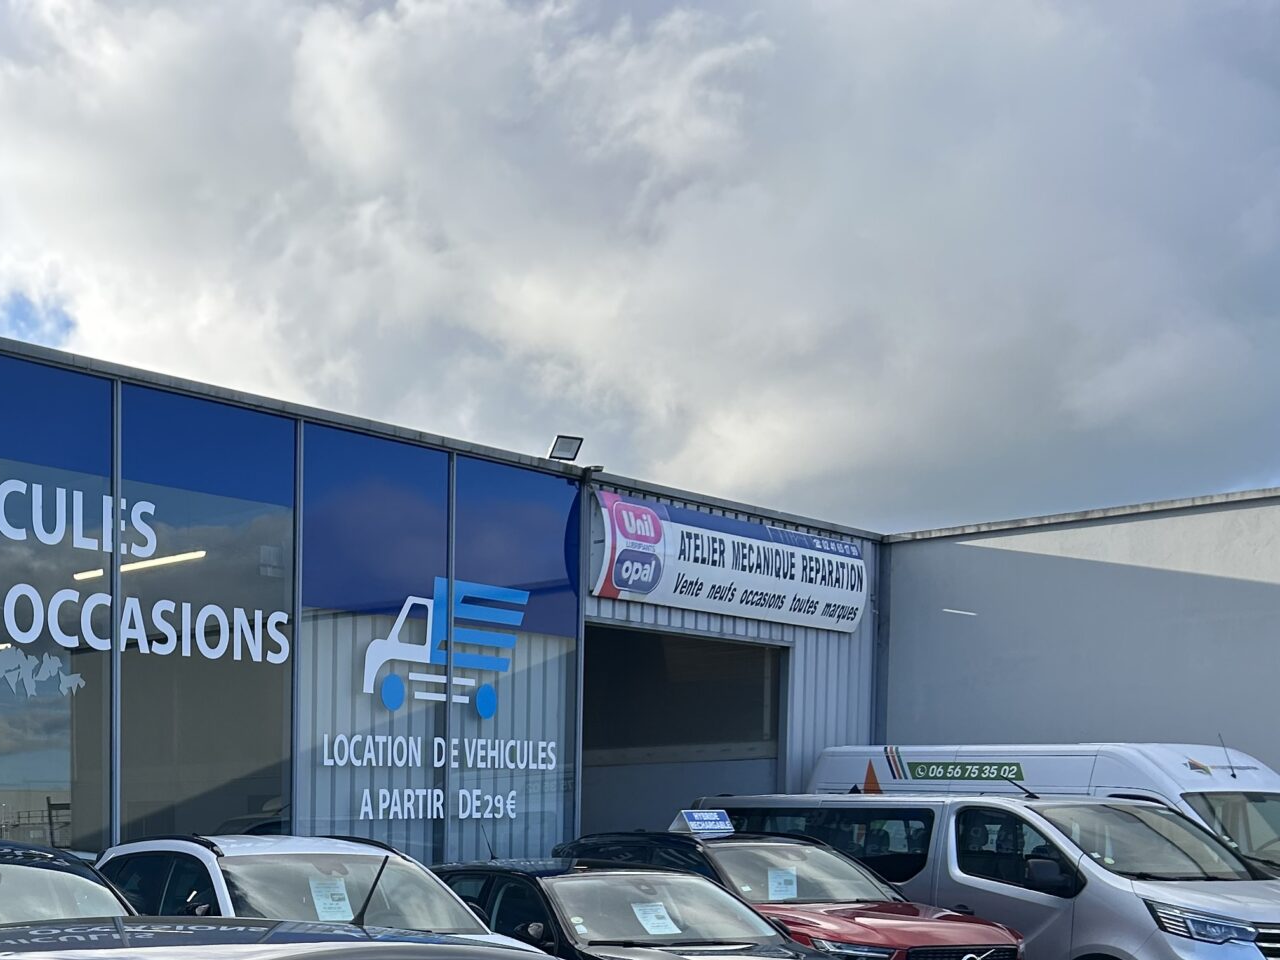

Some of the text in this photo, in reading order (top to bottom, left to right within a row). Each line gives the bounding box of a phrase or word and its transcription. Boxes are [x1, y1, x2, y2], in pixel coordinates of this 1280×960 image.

[622, 510, 655, 538] Unil
[622, 560, 656, 585] opal
[678, 530, 725, 568] ATELIER
[731, 541, 795, 580] MECANIQUE
[801, 554, 863, 592] REPARATION
[673, 572, 859, 624] Vente neufs occasions toutes marques
[3, 583, 290, 664] OCCASIONS
[323, 734, 557, 770] LOCATION DE VEHICULES
[928, 765, 1018, 778] 06 56 75 35 02
[359, 789, 373, 820] A
[379, 789, 444, 820] PARTIR
